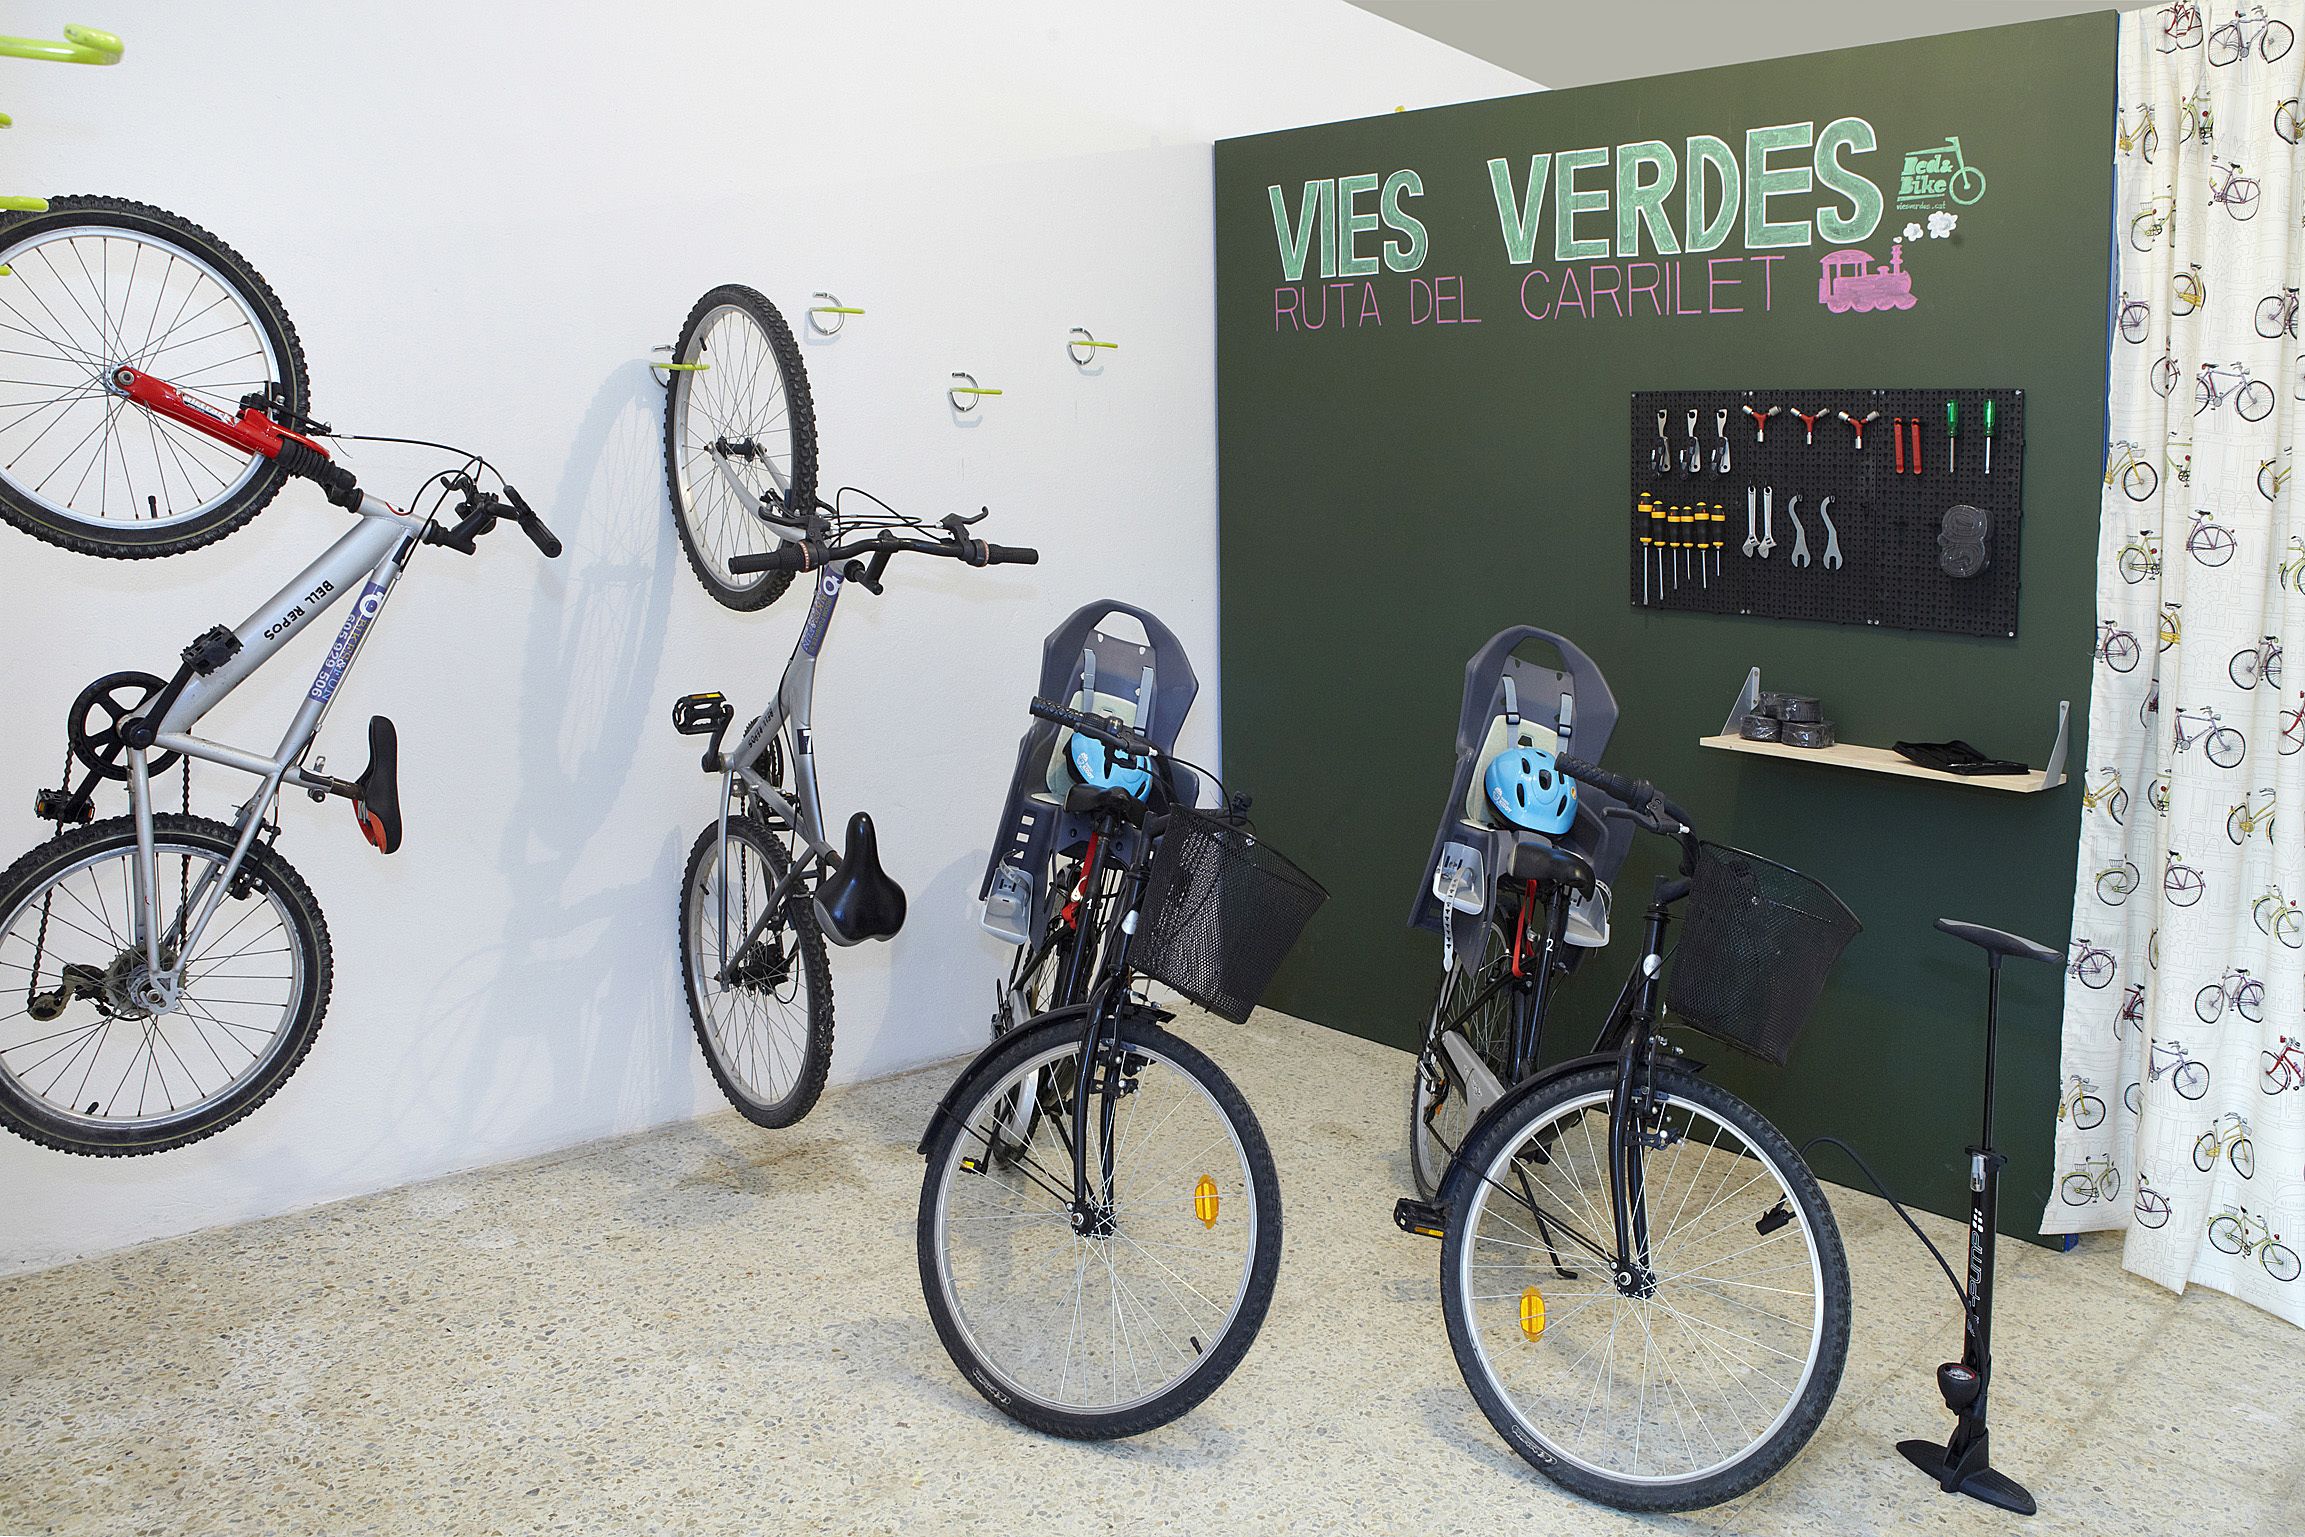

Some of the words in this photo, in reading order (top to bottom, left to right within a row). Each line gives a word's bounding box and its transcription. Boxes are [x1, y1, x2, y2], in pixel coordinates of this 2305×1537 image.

[1899, 175, 1947, 194] Bike
[1268, 167, 1429, 282] VIES
[1487, 117, 1884, 264] VERDES
[1274, 281, 1382, 332] RUTA
[1410, 276, 1482, 325] DEL
[1520, 256, 1785, 319] CARRILET
[305, 580, 334, 604] BELL
[264, 605, 305, 640] REPOS
[339, 614, 355, 640] 605
[325, 642, 343, 668] 929
[311, 670, 330, 697] 506
[1086, 898, 1092, 909] 1
[1545, 938, 1554, 952] 2
